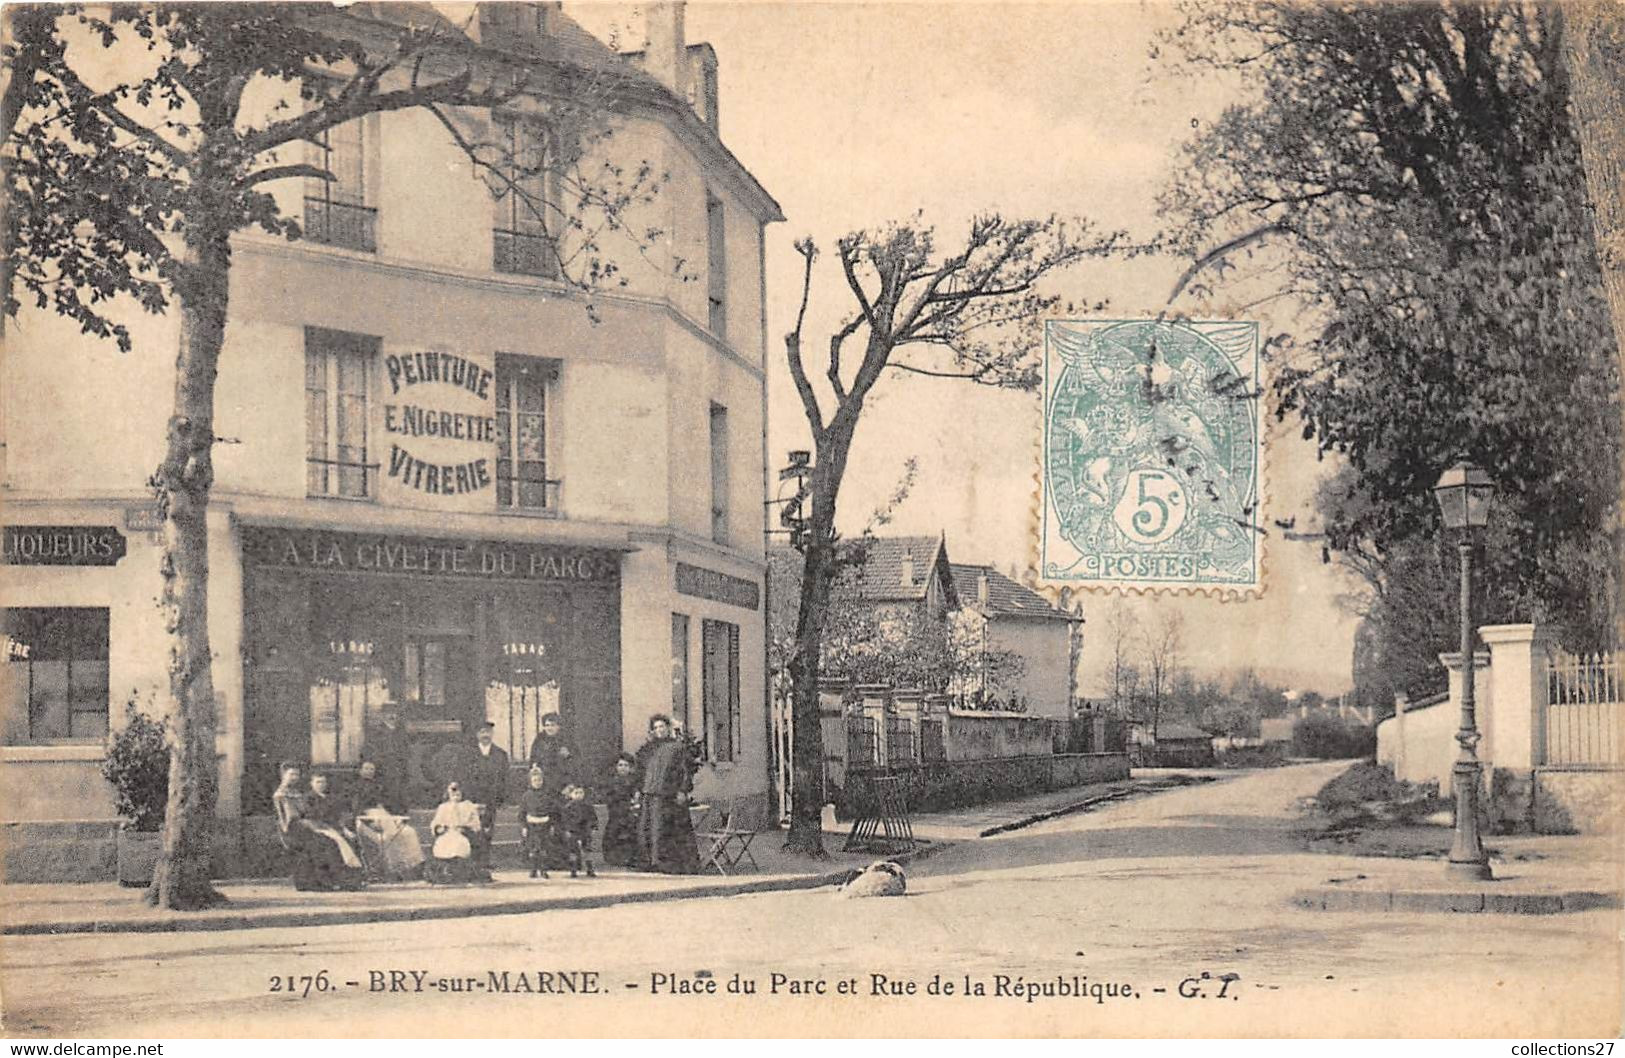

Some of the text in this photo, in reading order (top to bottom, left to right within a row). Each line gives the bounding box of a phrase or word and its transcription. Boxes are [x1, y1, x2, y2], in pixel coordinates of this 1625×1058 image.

[385, 352, 493, 400] PEINTURE
[388, 443, 491, 495] VITRERIE
[282, 537, 593, 578] A LA CIVETTE DU PARC
[1102, 555, 1194, 577] POSTES
[329, 640, 374, 654] TABAC
[502, 642, 545, 656] TABAC
